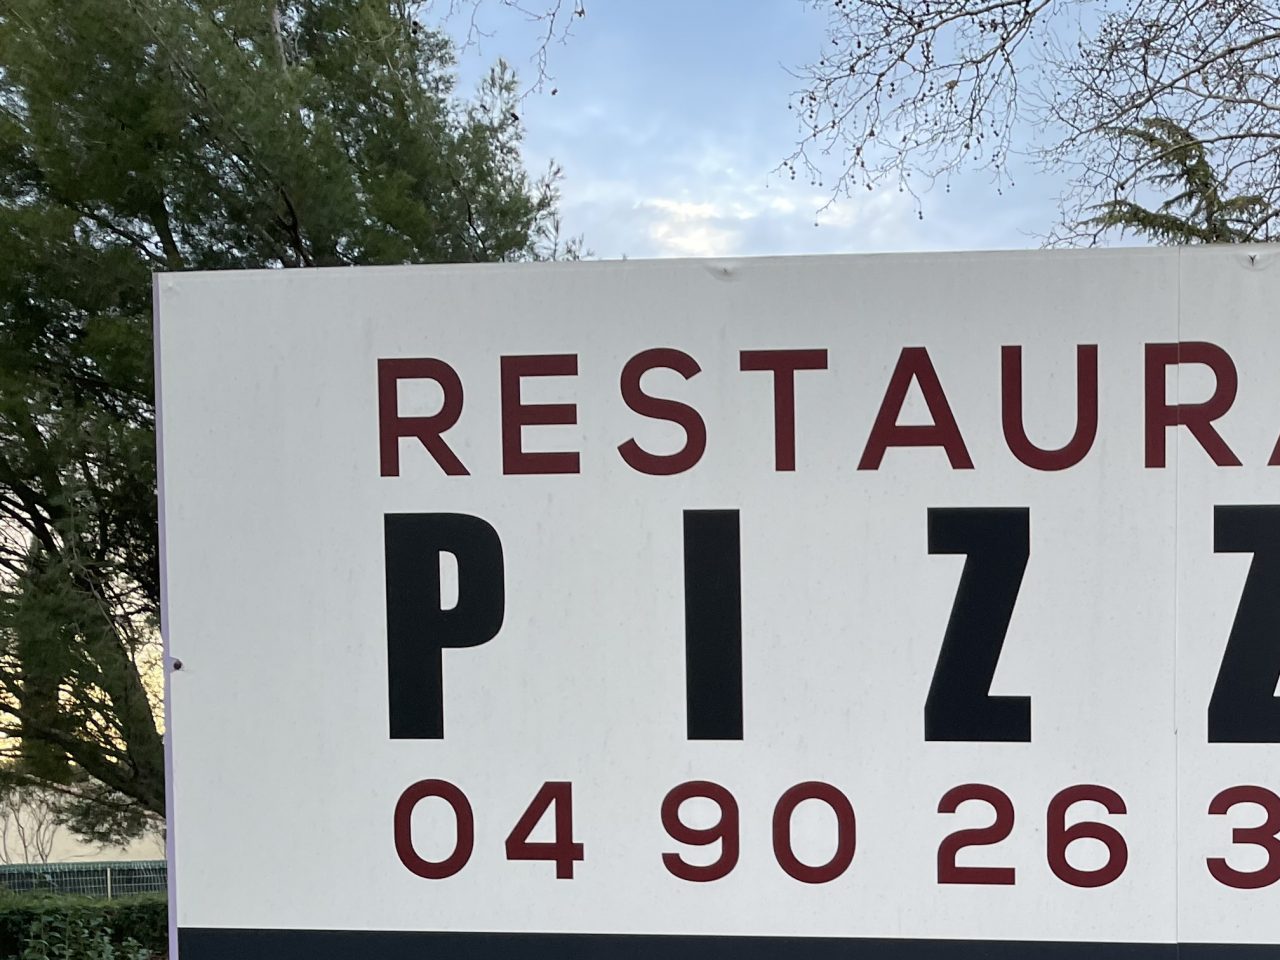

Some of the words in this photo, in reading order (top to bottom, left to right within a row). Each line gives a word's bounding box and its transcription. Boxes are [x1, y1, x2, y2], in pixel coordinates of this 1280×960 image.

[394, 779, 584, 879] 04
[661, 781, 856, 884] 90
[937, 784, 1128, 888] 26
